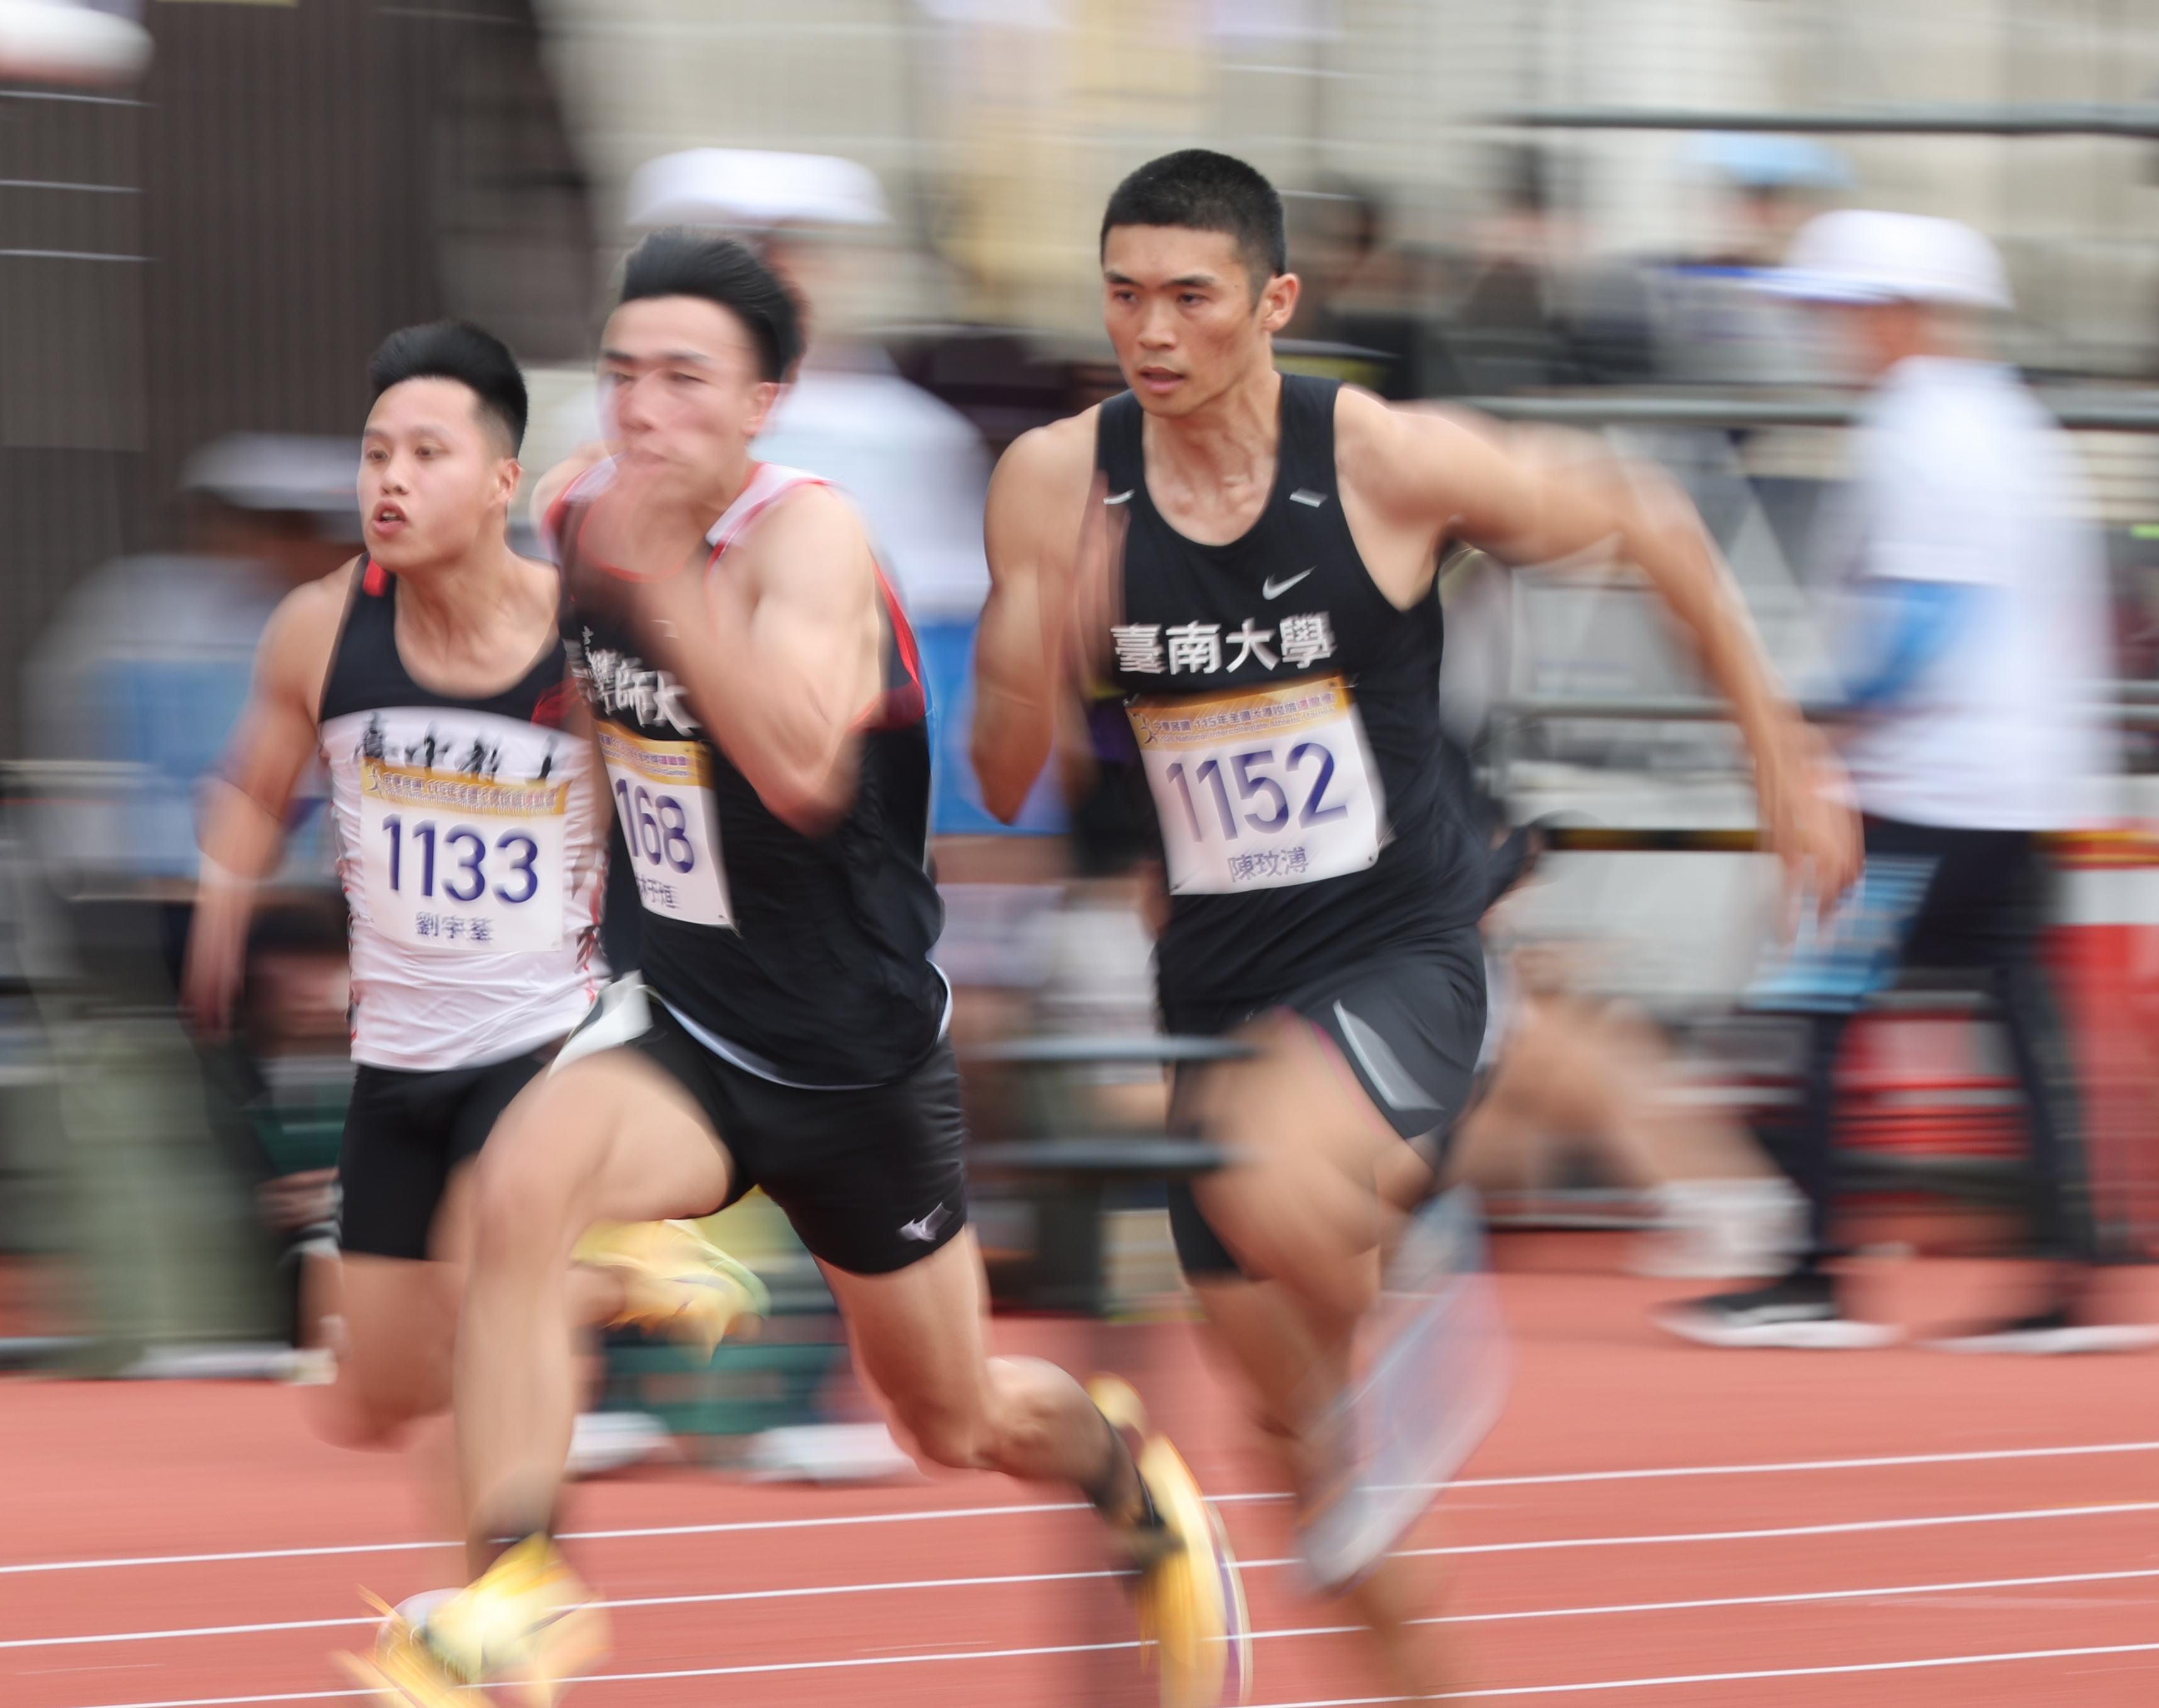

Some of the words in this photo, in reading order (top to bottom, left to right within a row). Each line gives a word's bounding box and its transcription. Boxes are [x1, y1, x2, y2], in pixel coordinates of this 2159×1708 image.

[1110, 610, 1338, 674] 臺南大學
[1166, 742, 1349, 842] 1152
[382, 813, 539, 904] 1133
[1227, 847, 1308, 883] 陳玟溥
